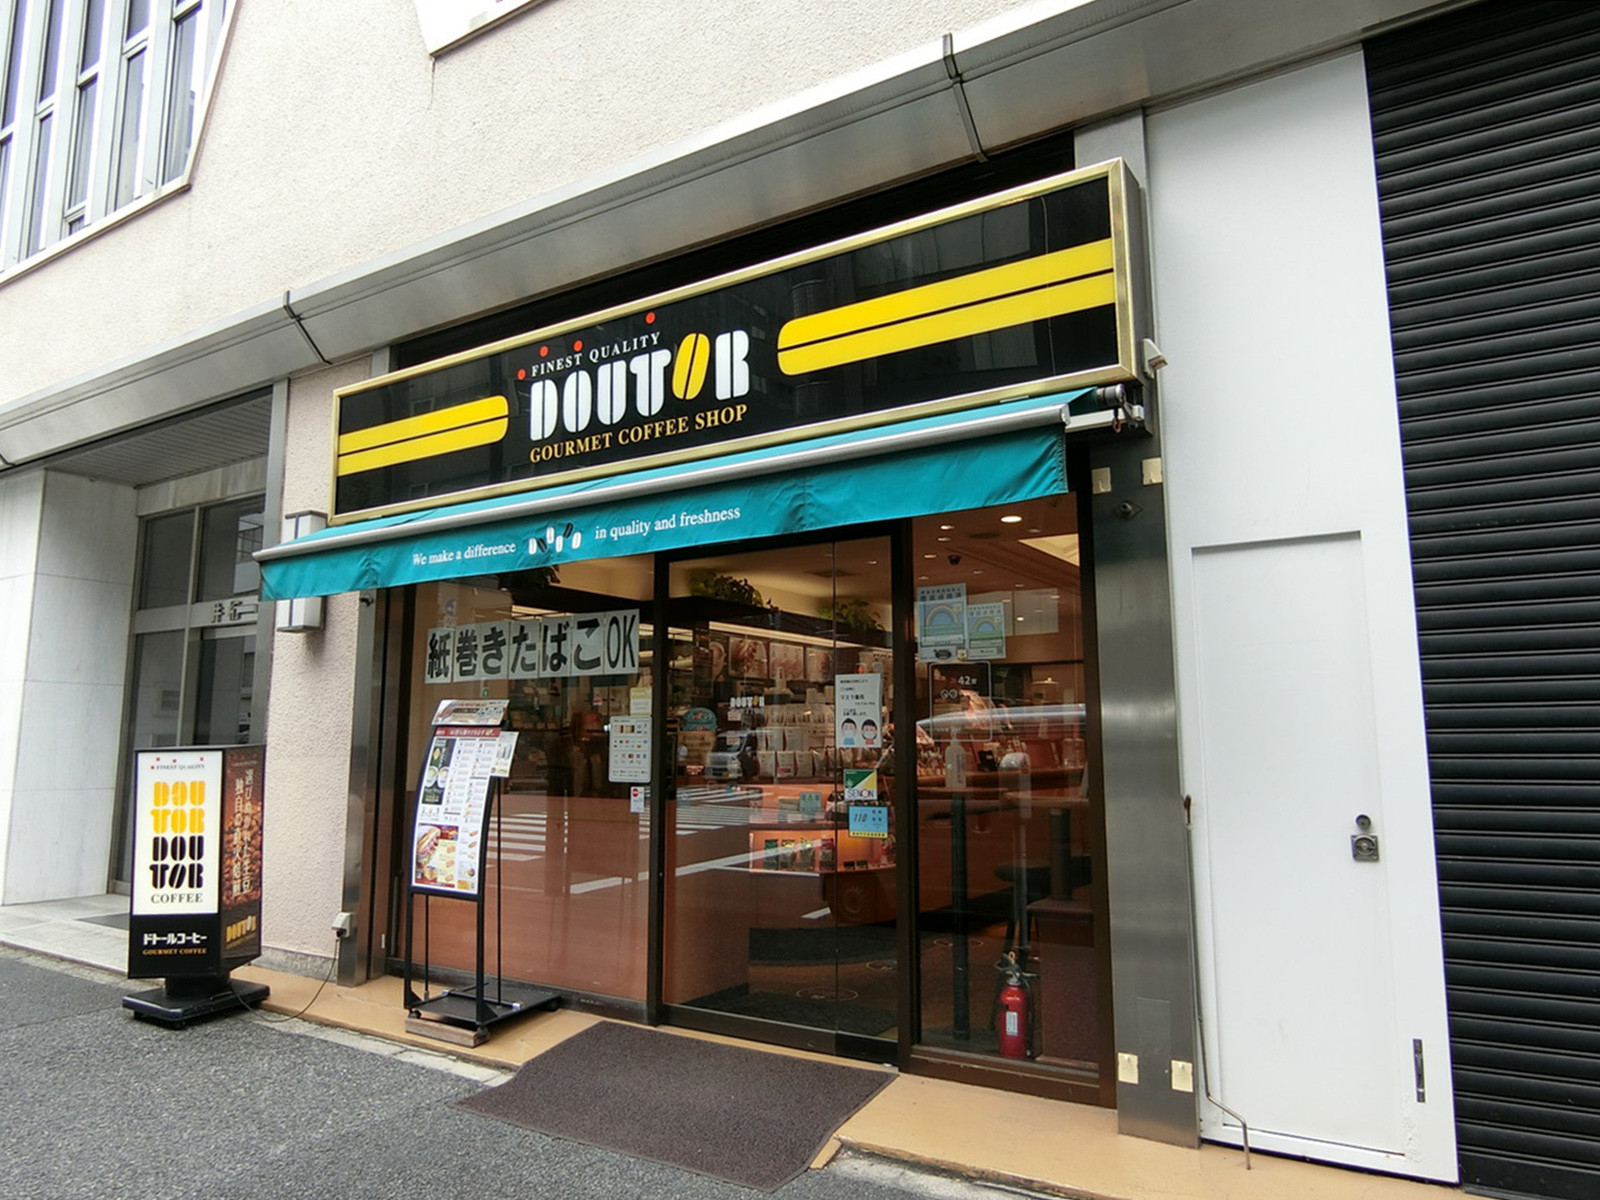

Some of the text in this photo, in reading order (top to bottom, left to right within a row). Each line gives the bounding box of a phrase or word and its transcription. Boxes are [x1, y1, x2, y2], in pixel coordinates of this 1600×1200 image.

[531, 331, 661, 377] FINEST QUALITY
[530, 330, 749, 441] DOUTOR
[529, 404, 748, 463] GOURMET COFFEE SHOP
[595, 506, 741, 540] in quality and freshness
[412, 541, 516, 566] We make a difference
[427, 614, 637, 678] 紙巻きたばこOK
[853, 812, 868, 823] 110
[151, 893, 203, 904] COFFEE
[143, 932, 208, 946] ドトールコーヒー
